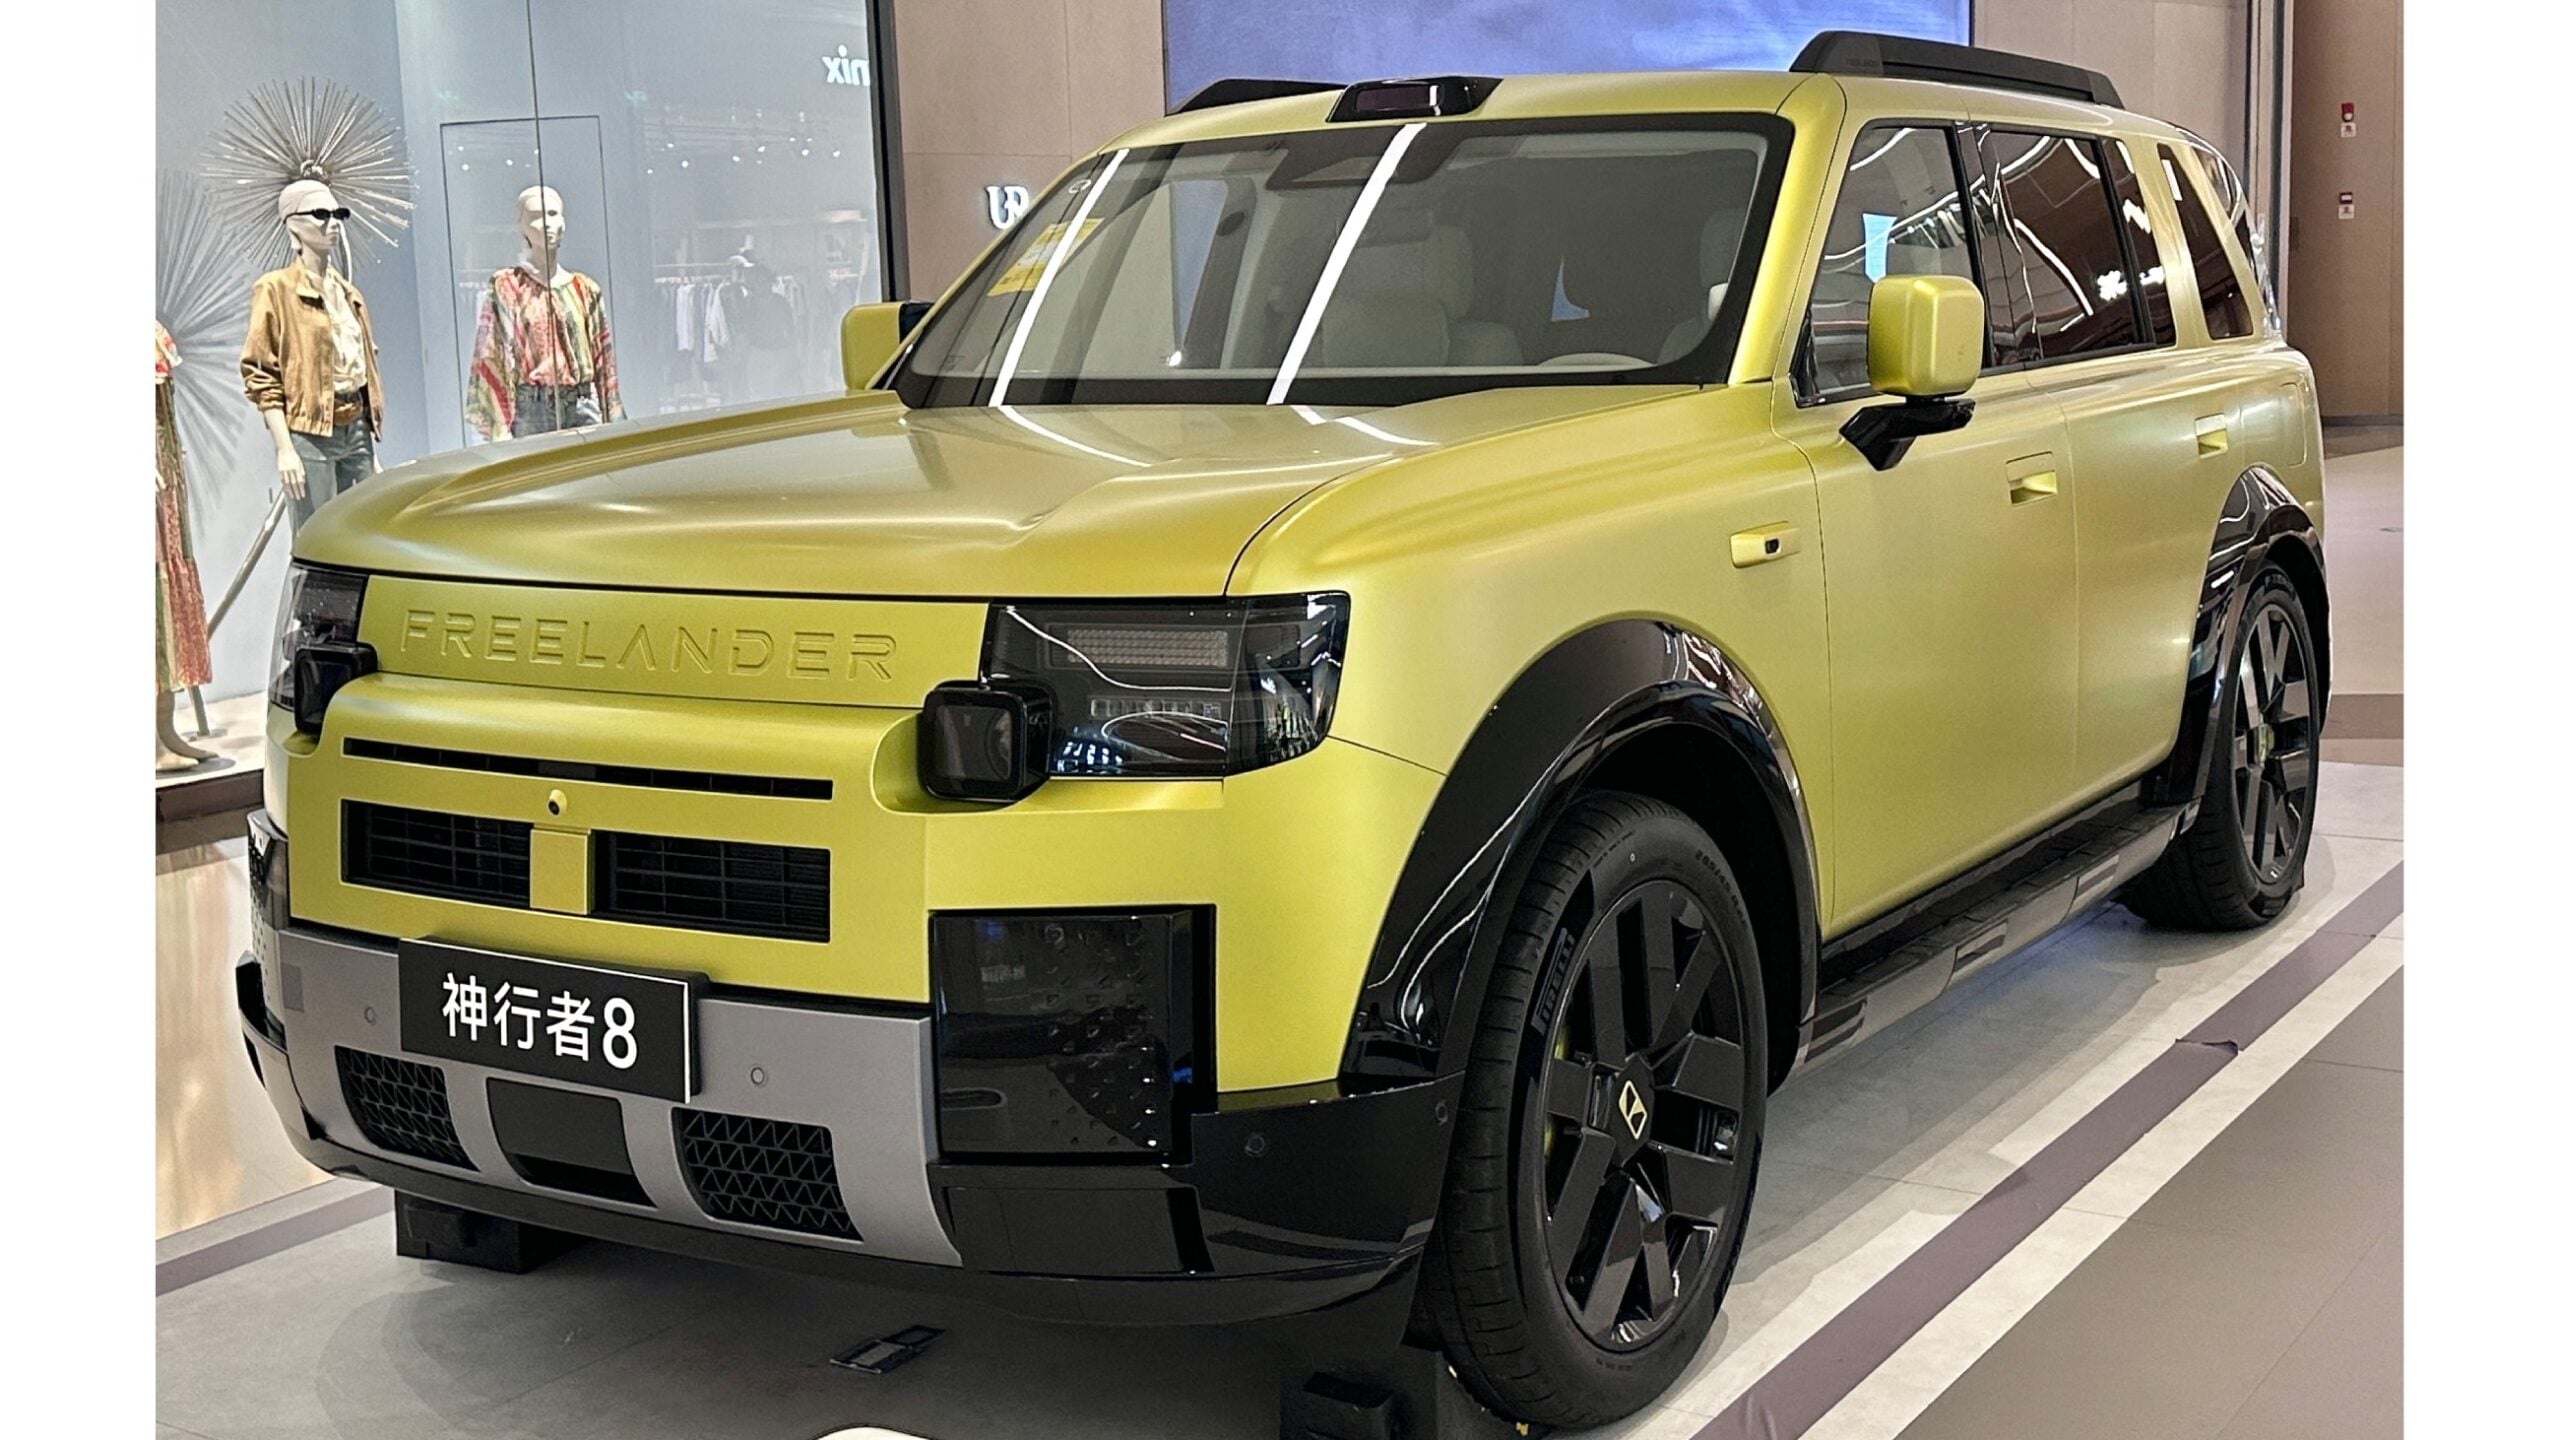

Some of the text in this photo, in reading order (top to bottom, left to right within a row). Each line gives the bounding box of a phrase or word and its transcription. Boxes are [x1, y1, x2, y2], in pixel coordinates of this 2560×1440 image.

[400, 608, 897, 682] FREELANDER
[441, 972, 638, 1070] 神行者8
